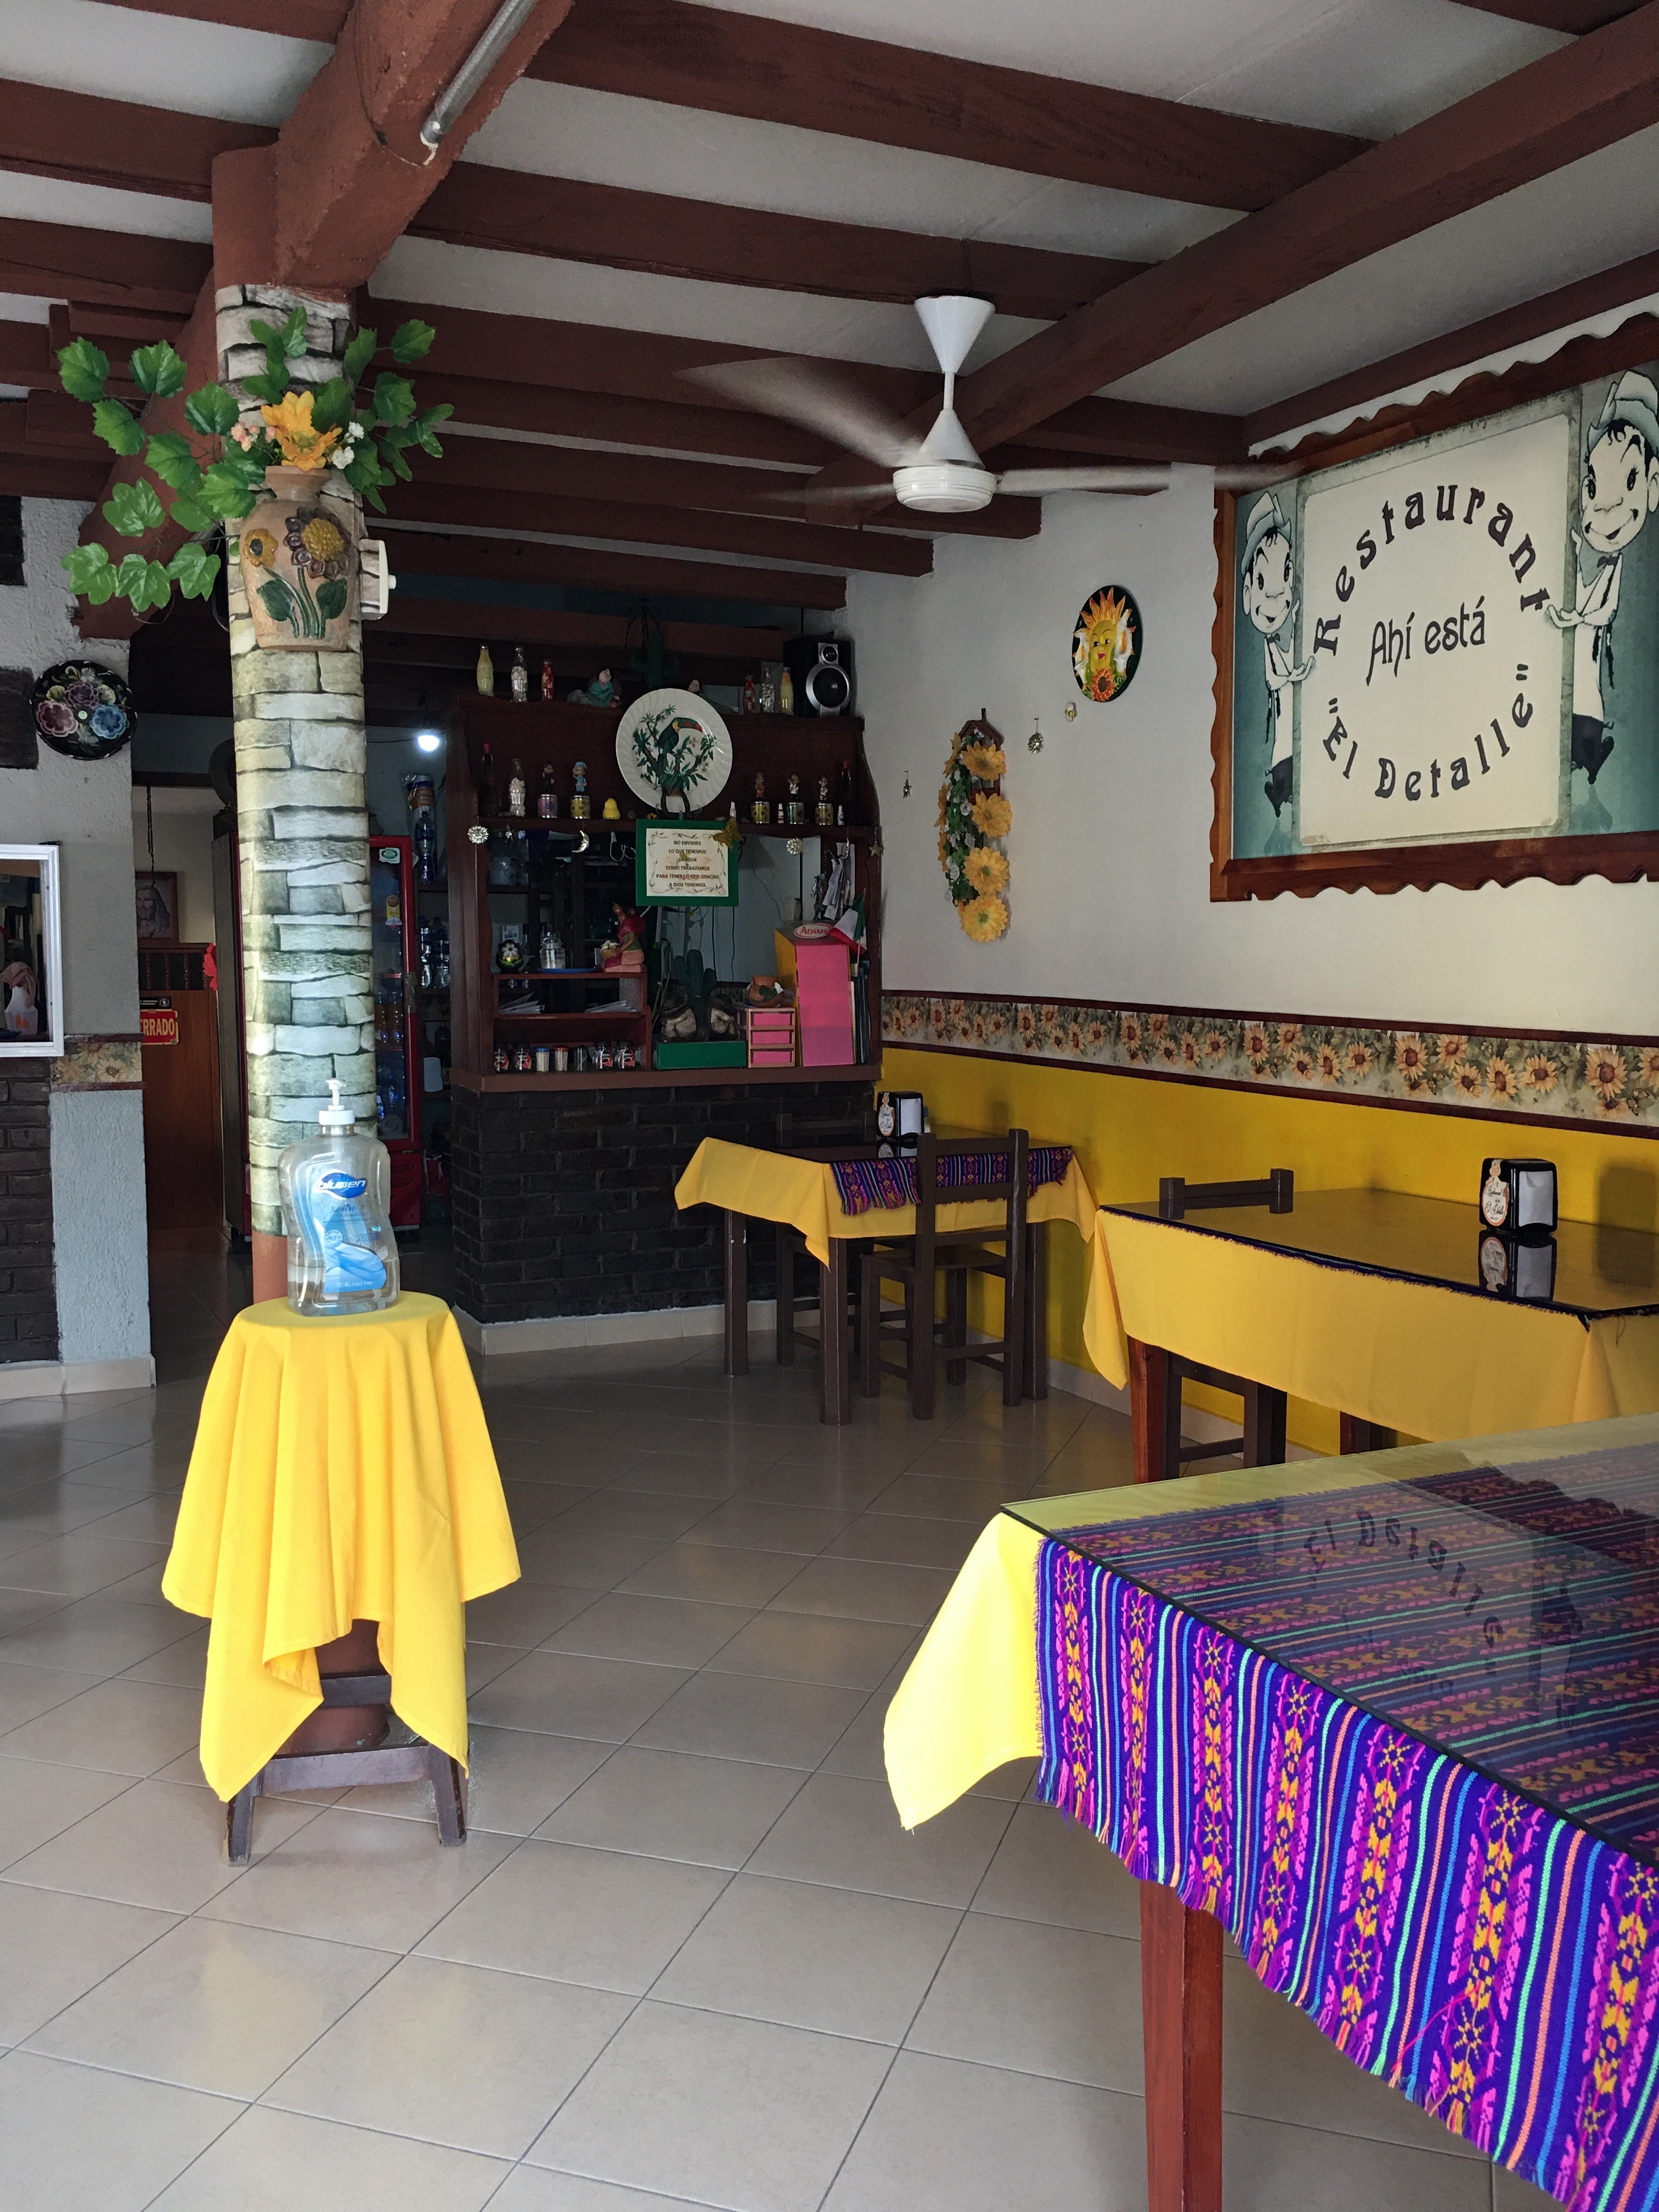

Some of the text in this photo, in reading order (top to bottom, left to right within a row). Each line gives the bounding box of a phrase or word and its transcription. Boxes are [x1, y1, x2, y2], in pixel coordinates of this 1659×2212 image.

[1314, 484, 1551, 657] Restaurant
[1366, 595, 1486, 687] Ahí está
[800, 926, 828, 934] ADAMS
[140, 1018, 175, 1036] RRADO
[317, 1179, 366, 1189] blumen
